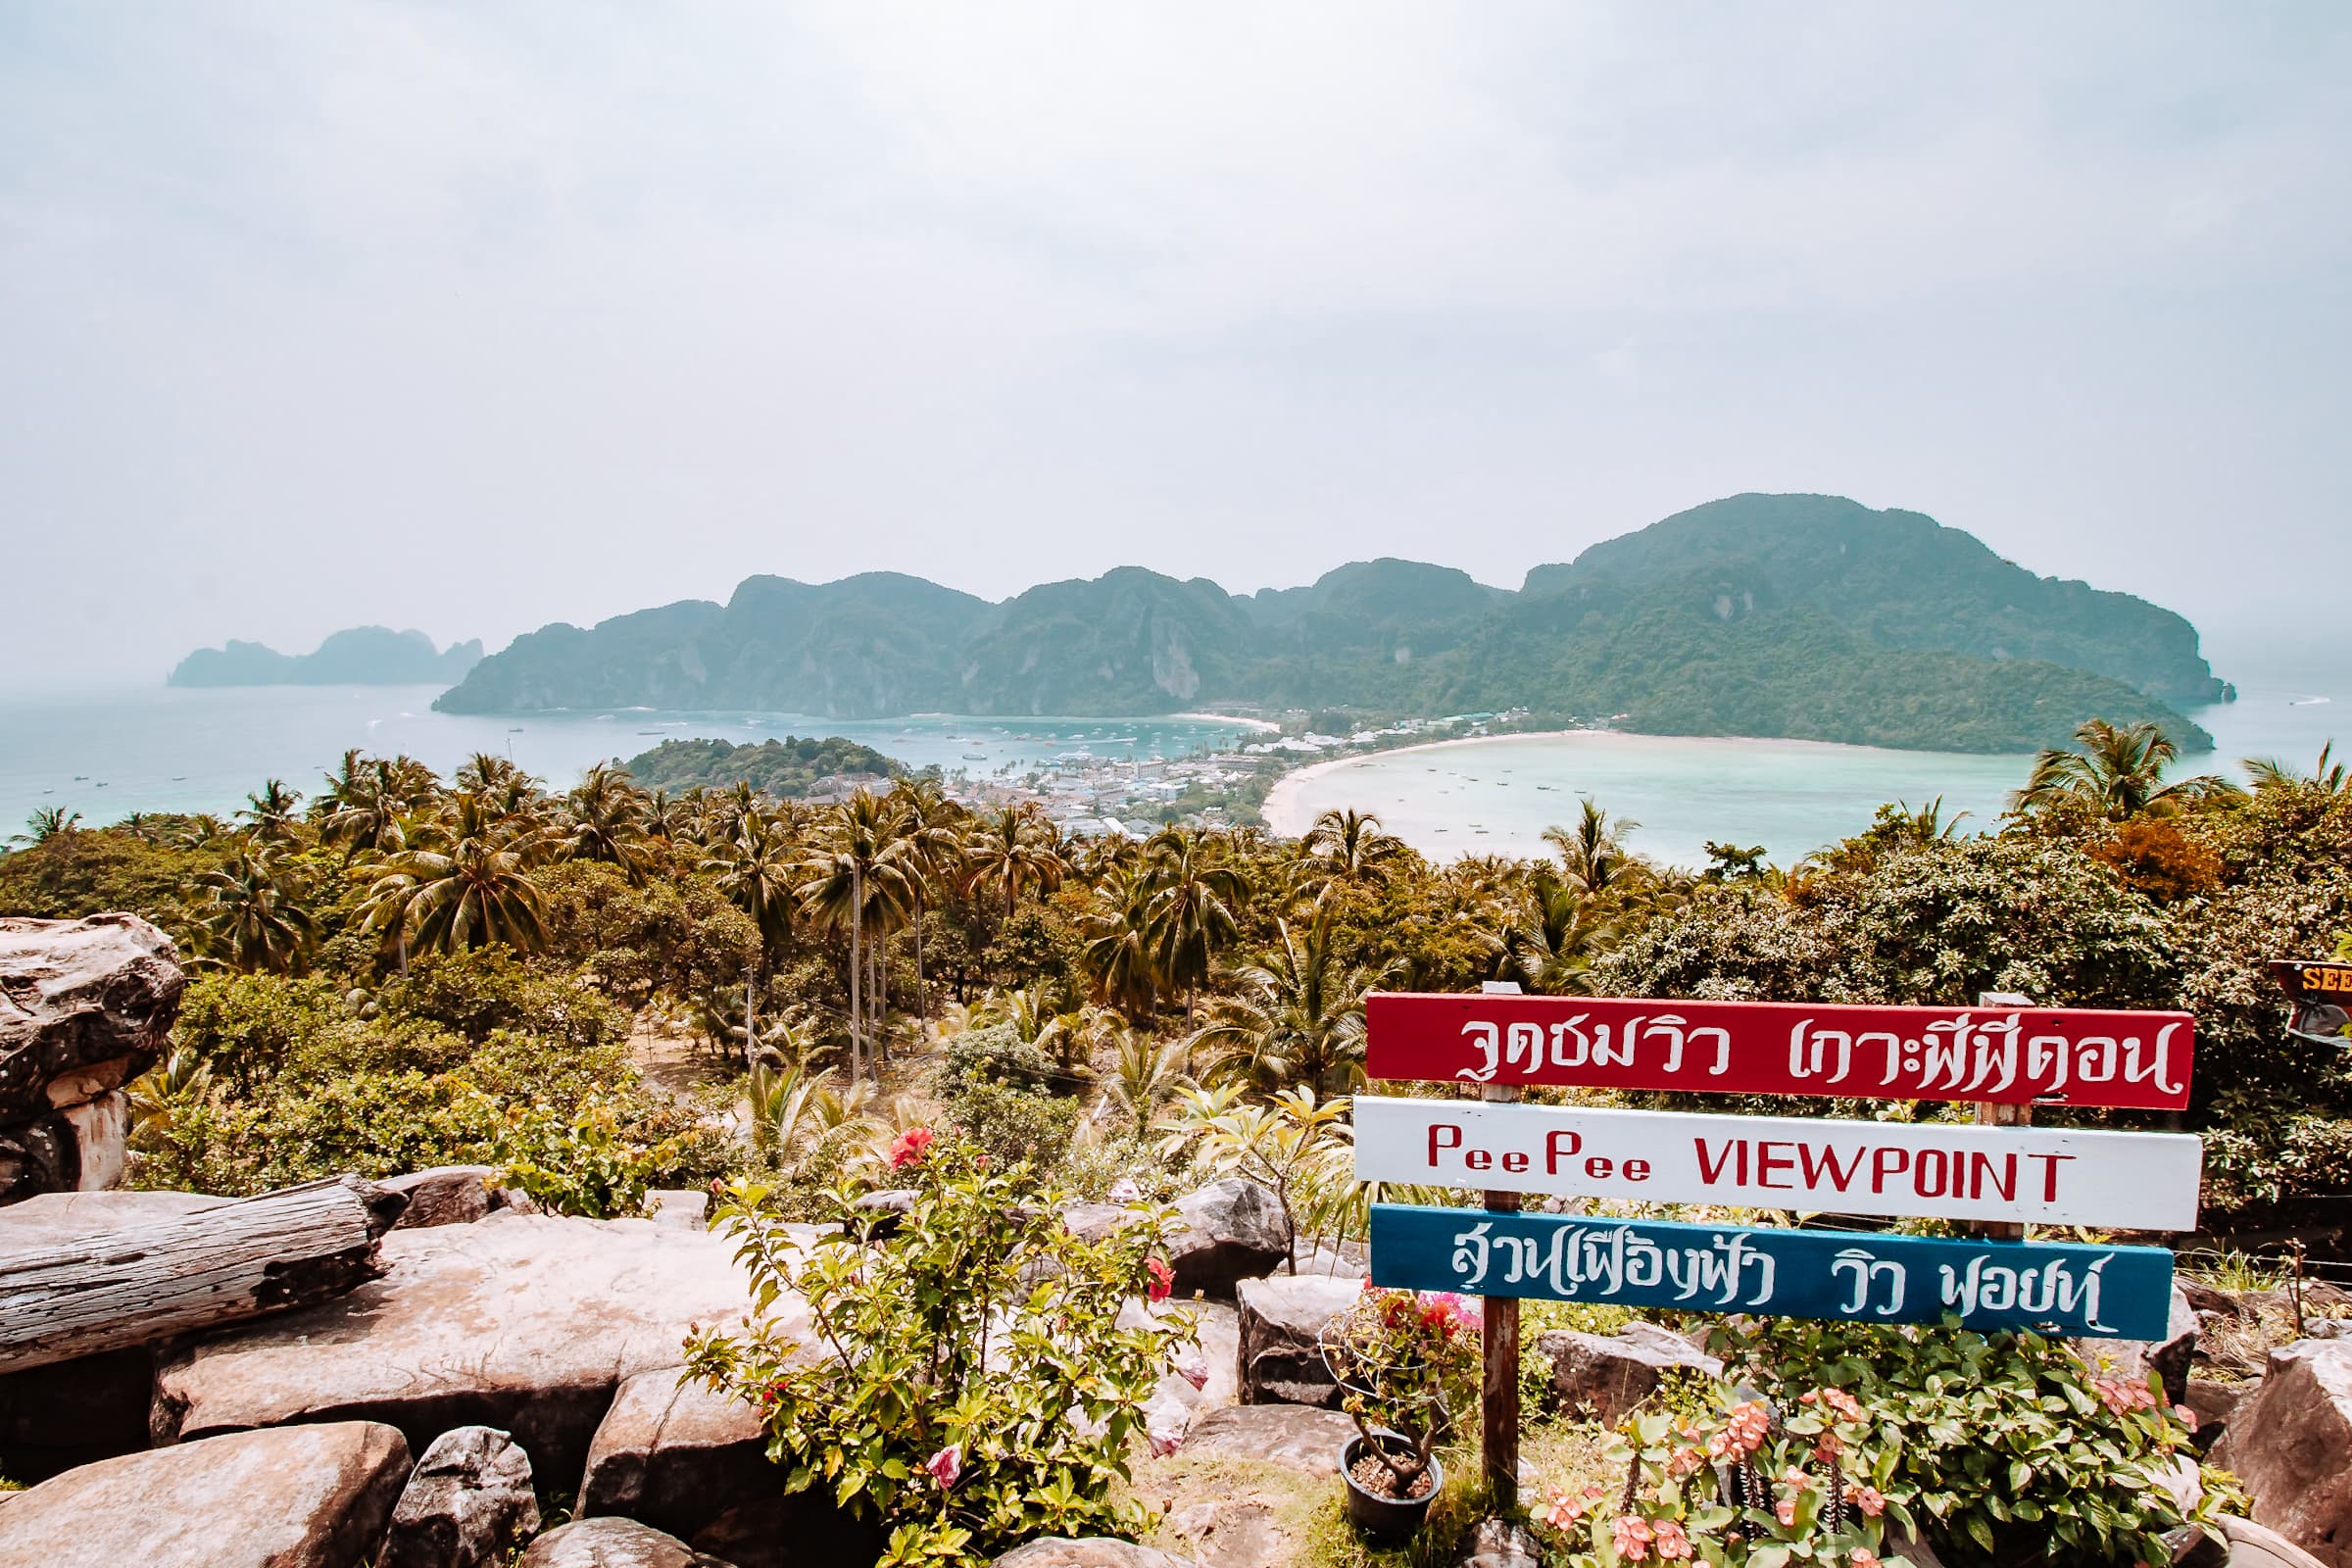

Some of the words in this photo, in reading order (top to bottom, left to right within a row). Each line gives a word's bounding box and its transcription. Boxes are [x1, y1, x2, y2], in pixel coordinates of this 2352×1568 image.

[1454, 1013, 1731, 1081] จุดชมวิว
[1693, 1138, 2078, 1202] VIEWPOINT
